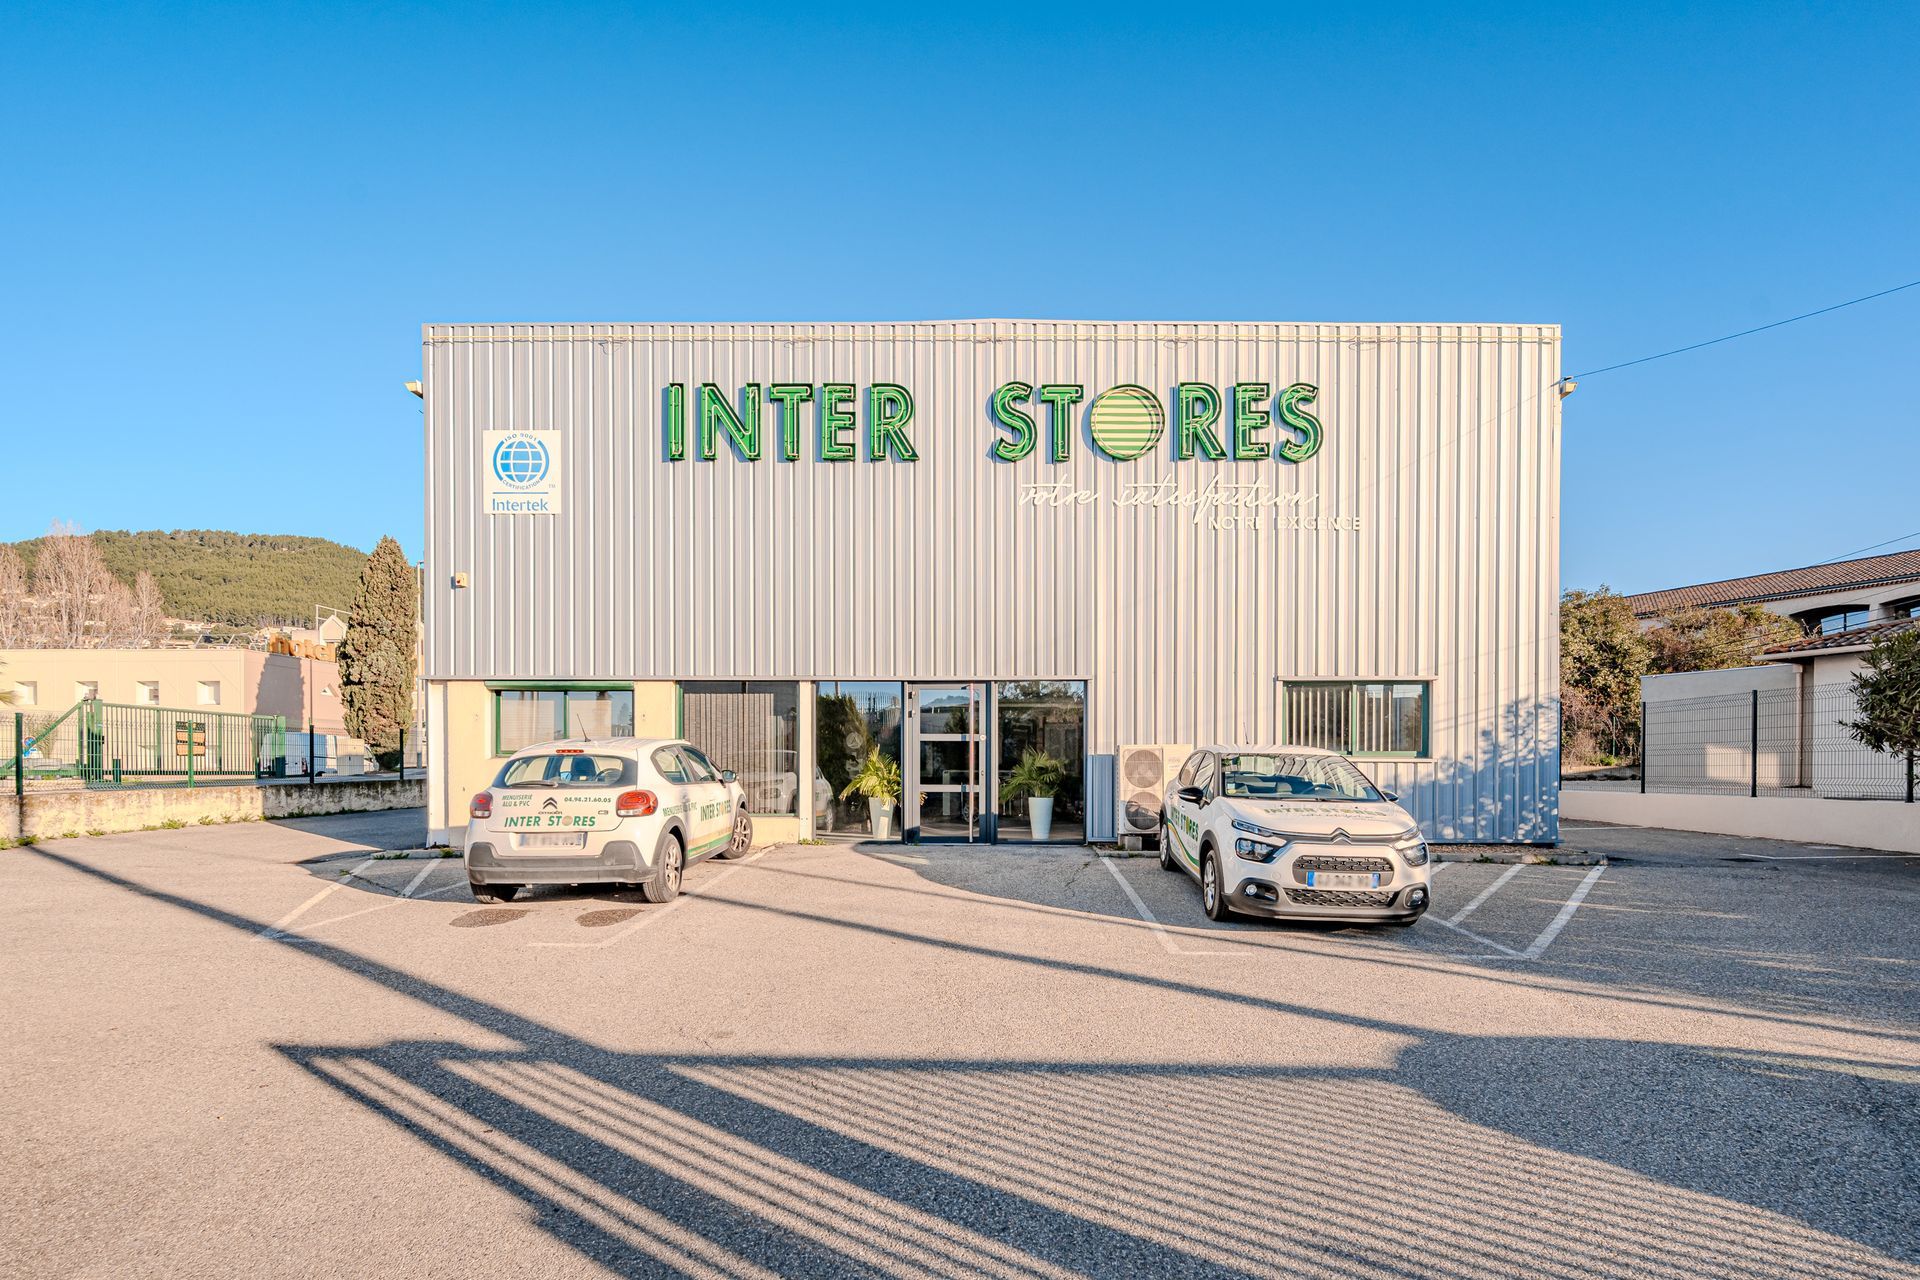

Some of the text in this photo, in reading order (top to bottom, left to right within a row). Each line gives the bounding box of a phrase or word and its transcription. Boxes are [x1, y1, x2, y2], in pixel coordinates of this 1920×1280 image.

[668, 381, 1324, 463] INTER STORES
[504, 433, 517, 442] ISO
[502, 479, 541, 491] CERTIFICATION
[1018, 473, 1100, 507] votre
[492, 498, 549, 511] Intertek
[1207, 516, 1361, 530] NOTRE EXIGENCE
[504, 815, 596, 828] INTER STORES
